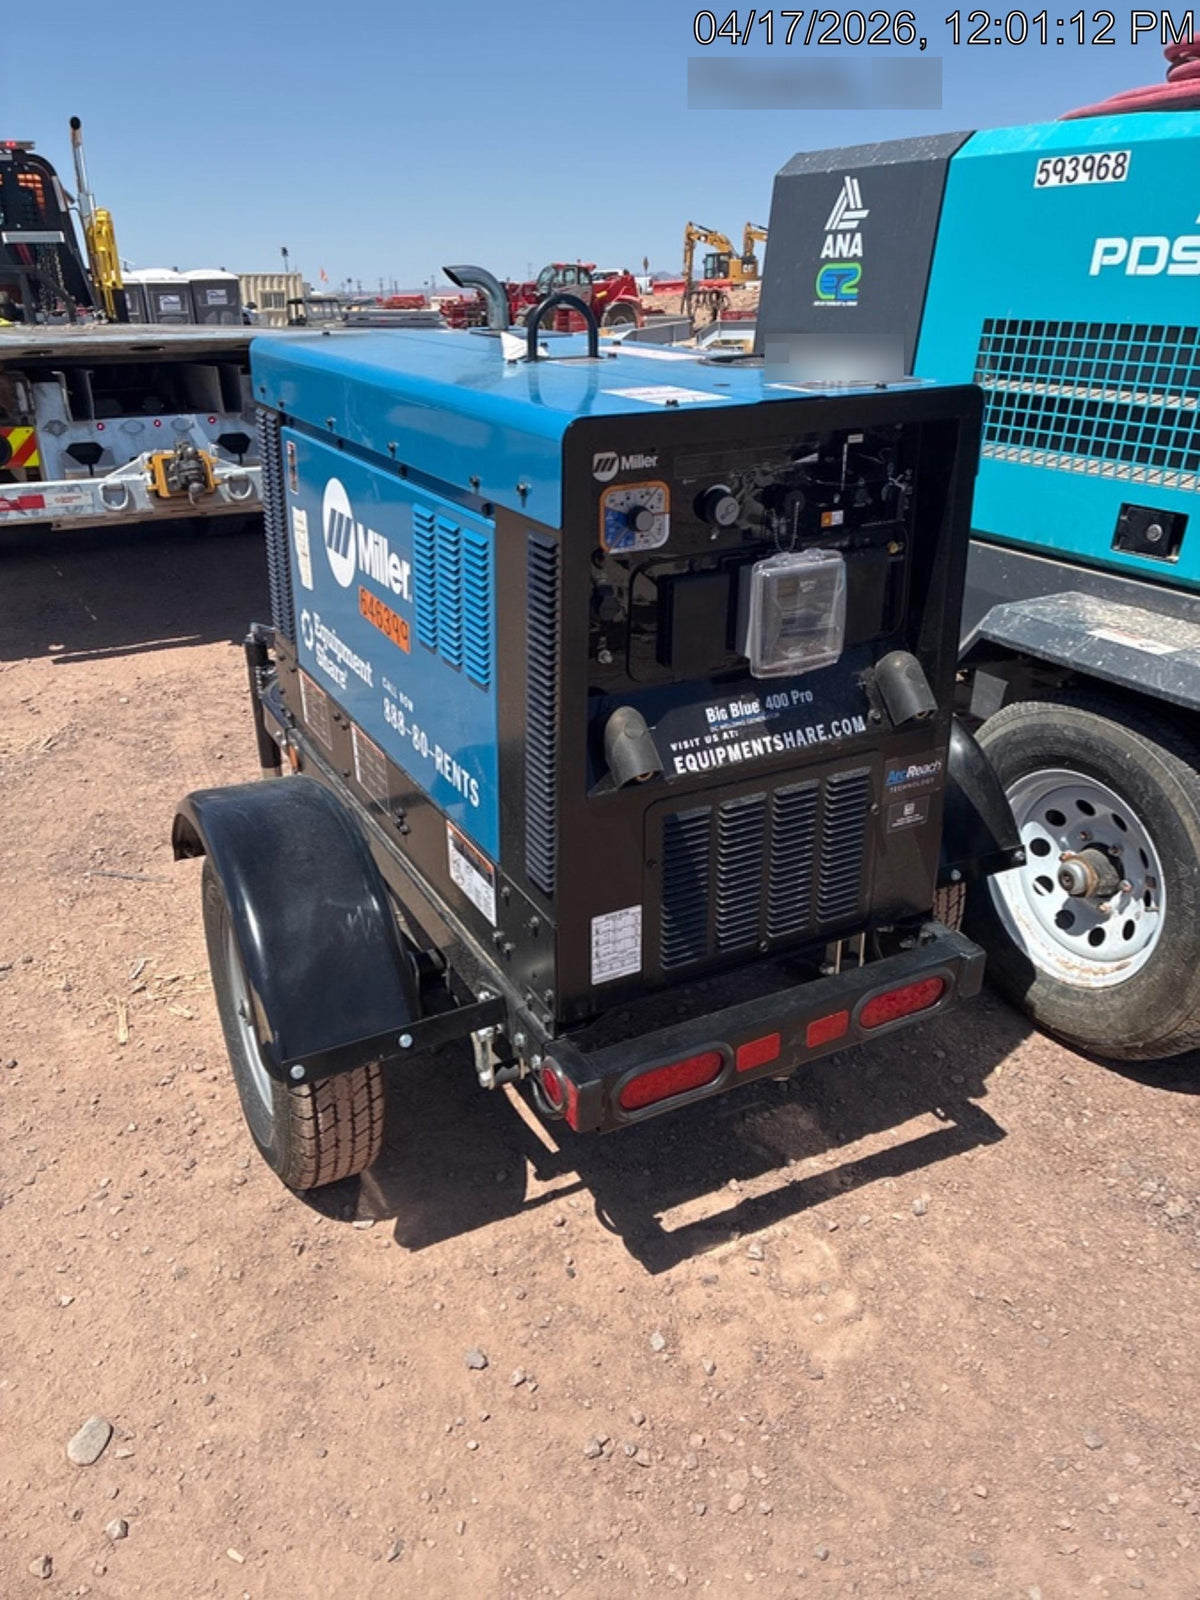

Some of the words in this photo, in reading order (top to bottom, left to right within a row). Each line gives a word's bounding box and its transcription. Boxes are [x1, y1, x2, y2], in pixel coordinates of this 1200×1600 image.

[1036, 152, 1128, 186] 593968
[820, 232, 863, 259] ANA
[621, 454, 658, 471] Miller
[356, 521, 411, 603] Miller
[312, 612, 374, 688] Equipment
[705, 705, 729, 724] Big
[729, 700, 760, 718] Blue
[766, 692, 789, 710] 400
[791, 689, 814, 706] Pro
[383, 697, 480, 809] 888-80-RENTS
[669, 738, 700, 752] VISIT
[703, 733, 720, 745] US
[674, 716, 866, 775] EQUIPMENTSHARE.COM
[887, 760, 942, 783] ArcReach
